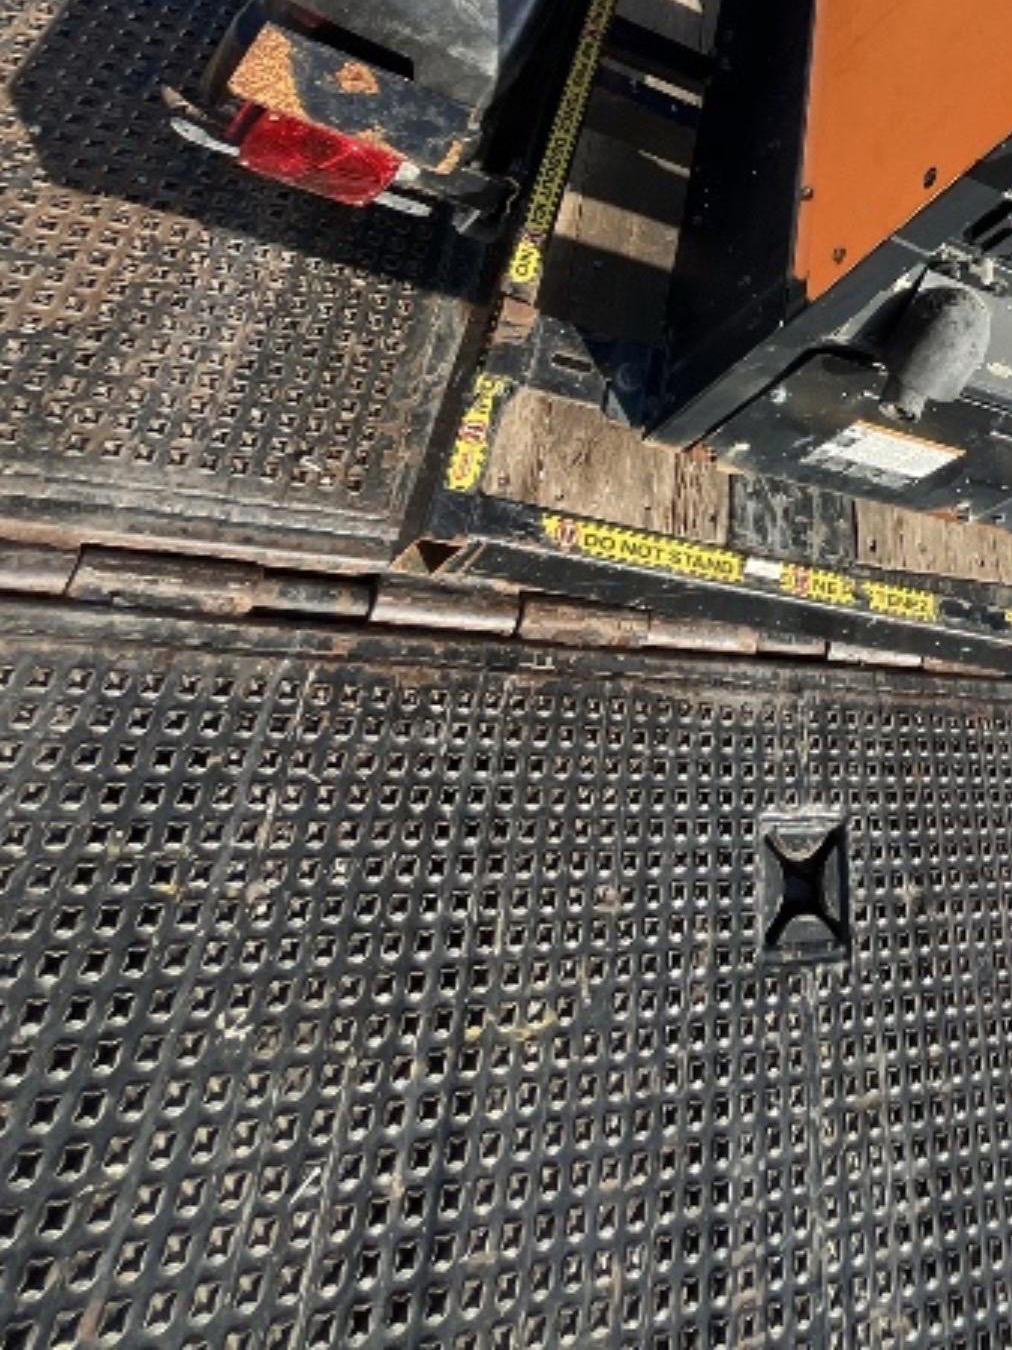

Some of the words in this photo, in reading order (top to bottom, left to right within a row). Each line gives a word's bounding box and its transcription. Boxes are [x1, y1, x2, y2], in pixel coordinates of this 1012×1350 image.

[583, 533, 616, 550] DO
[620, 539, 662, 564] NOT
[668, 552, 733, 574] STAND
